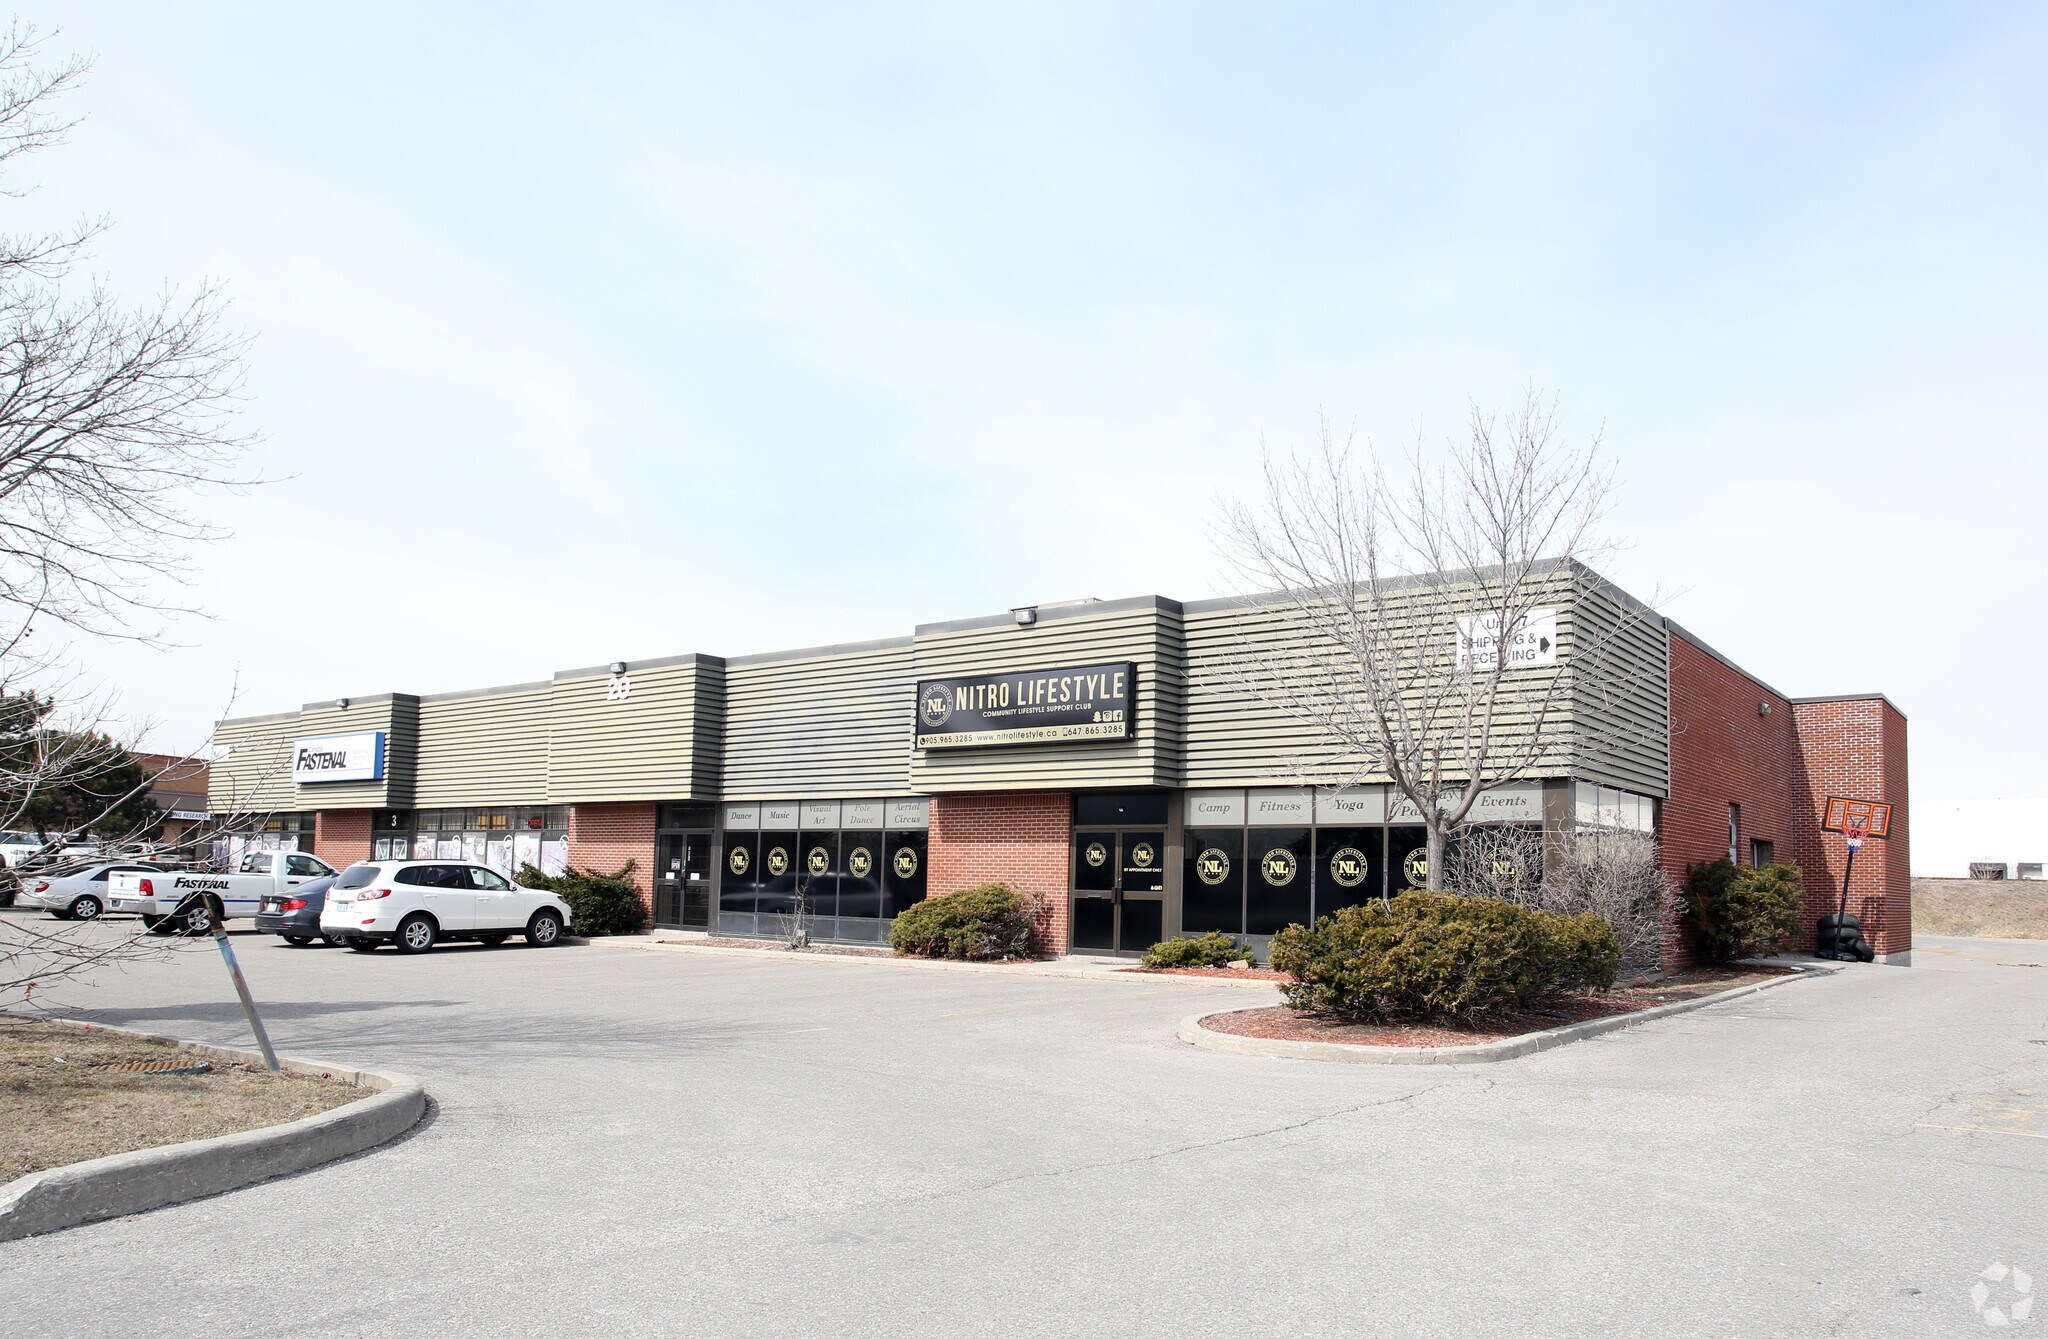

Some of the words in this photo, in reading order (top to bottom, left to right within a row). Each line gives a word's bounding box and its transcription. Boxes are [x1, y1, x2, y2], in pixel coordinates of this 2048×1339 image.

[1486, 617, 1510, 629] Uni
[1461, 633, 1524, 649] SHIPPG
[1527, 632, 1537, 644] &
[1461, 648, 1536, 665] RECEING
[607, 676, 630, 700] 20
[955, 682, 1009, 711] NITRO
[1017, 672, 1125, 706] LIFESTYLE
[926, 698, 946, 713] NL
[982, 708, 1017, 718] COMMUNITY
[1018, 706, 1045, 715] LIFESTYLE
[1046, 704, 1074, 713] SUPPORT
[925, 734, 973, 745] 905.965.3285
[976, 730, 1057, 741] www.nitrolifestyle.ca
[1067, 725, 1123, 736] 647.865.3285
[1259, 801, 1302, 812] Fitness
[1335, 799, 1364, 812] Yoga
[1480, 795, 1527, 807] Events
[809, 804, 832, 813] Visual
[854, 803, 872, 812] Pole
[894, 802, 920, 812] Aerial
[1198, 802, 1231, 814] Camp
[731, 811, 752, 820] Dance
[769, 811, 790, 819] Music
[850, 815, 874, 824] Dance
[894, 814, 920, 824] Circus
[391, 815, 397, 827] 3
[813, 817, 826, 825] Art
[1090, 850, 1102, 859] NL
[1137, 850, 1150, 859] NL
[733, 855, 746, 866] NL
[771, 856, 784, 866] NL
[812, 856, 825, 867] NL
[853, 856, 867, 867] NL
[898, 857, 913, 868] NL
[1203, 860, 1223, 873] NL
[1268, 861, 1289, 874] NL
[1338, 860, 1360, 874] NL
